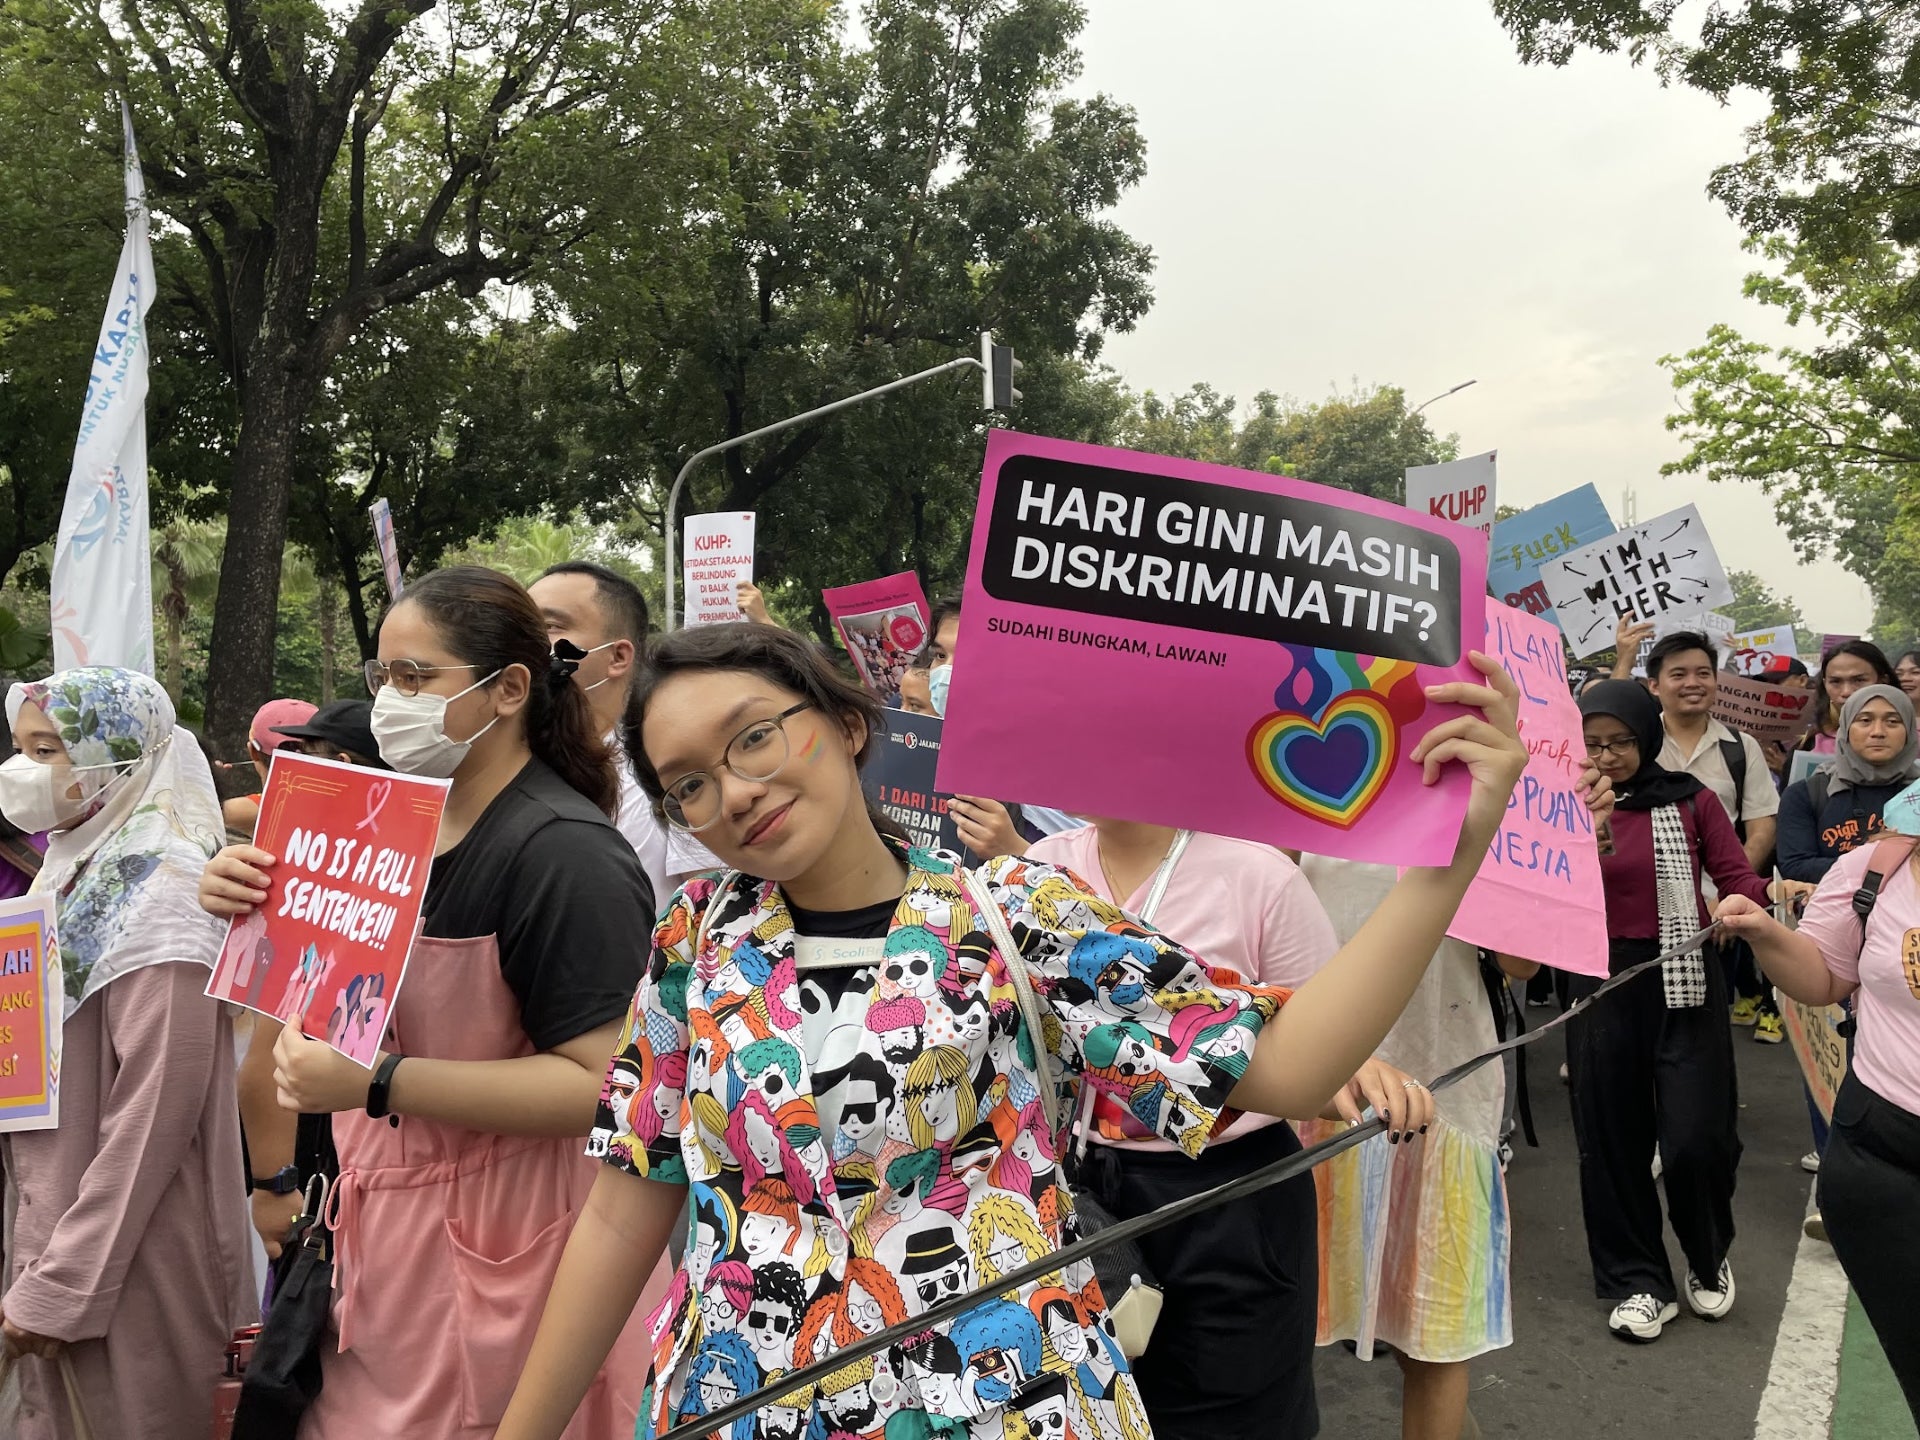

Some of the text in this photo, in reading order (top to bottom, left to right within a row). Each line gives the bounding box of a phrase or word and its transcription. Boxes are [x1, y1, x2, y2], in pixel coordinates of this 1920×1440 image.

[1429, 484, 1487, 521] KUHP
[694, 534, 732, 552] KUHP:
[1016, 479, 1441, 592] HARI GINI MASIH
[1599, 537, 1643, 575] I'M
[691, 569, 737, 581] BERLINDUNG
[700, 583, 730, 593] DI BALIK
[1010, 535, 1438, 643] DISKRIMINATIF?
[1583, 551, 1672, 606] WITH
[698, 611, 742, 622] PEREMPUAN
[1611, 580, 1686, 624] HER
[987, 616, 1228, 669] SUDAHI BUNGKAM, LAWAN!
[879, 785, 949, 815] 1 DARI 10
[284, 826, 416, 898] NO IS A FULL
[277, 876, 398, 951] SENTENCE!!!
